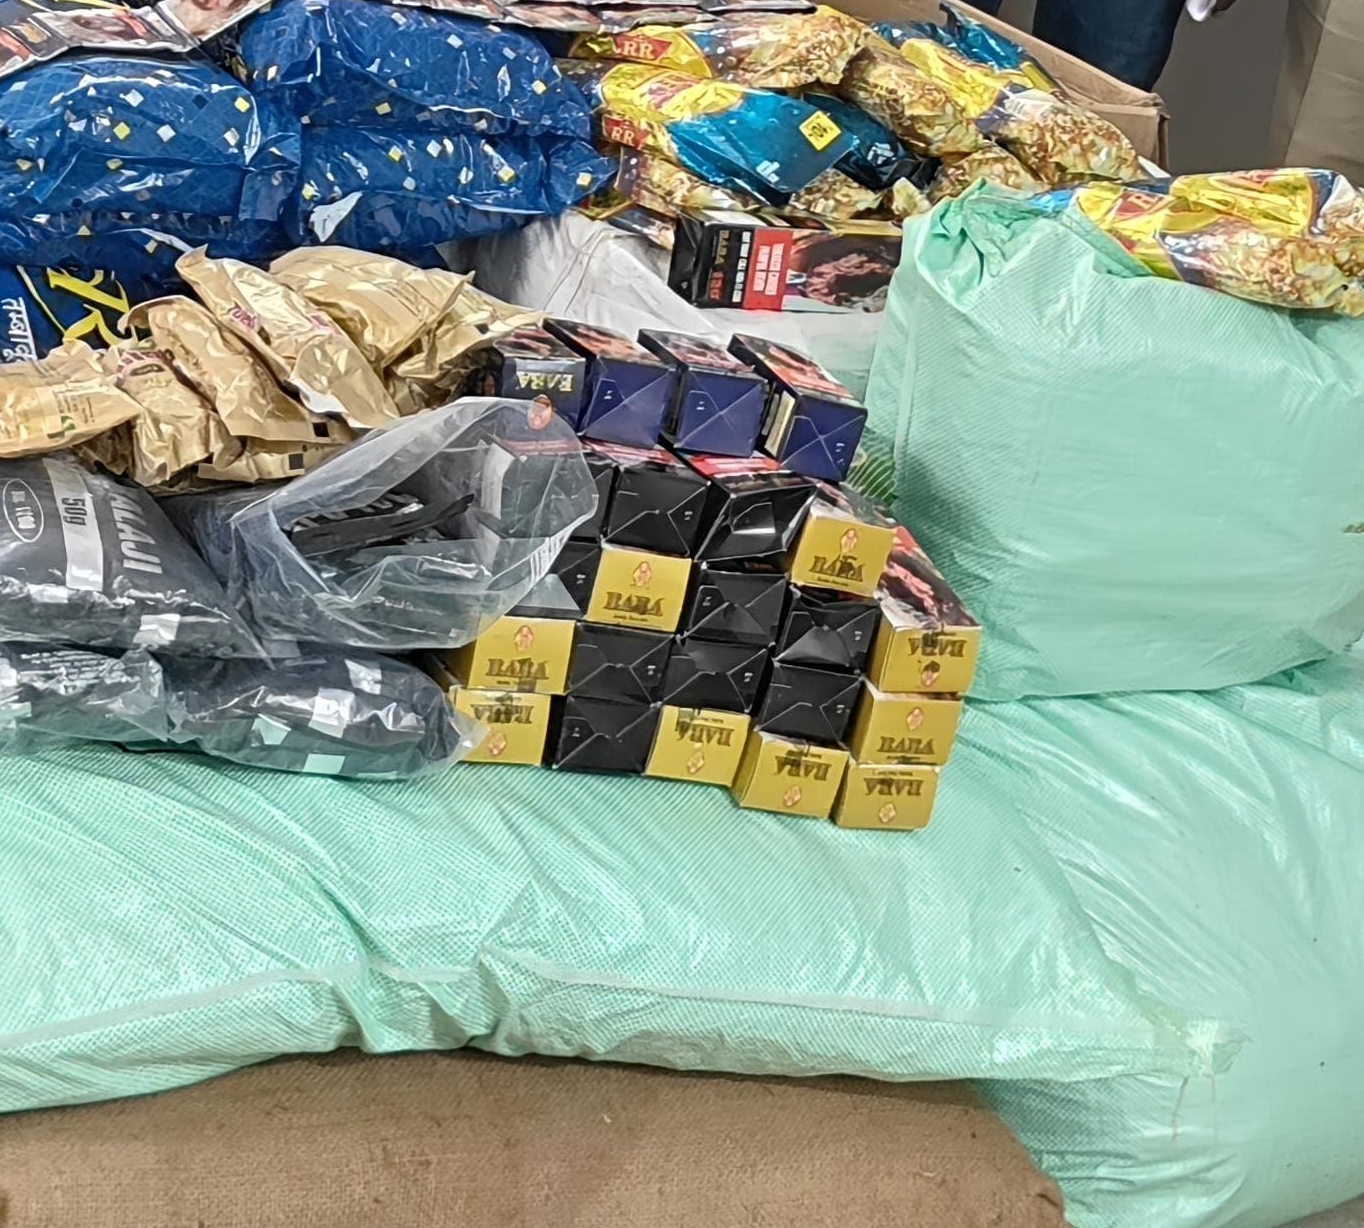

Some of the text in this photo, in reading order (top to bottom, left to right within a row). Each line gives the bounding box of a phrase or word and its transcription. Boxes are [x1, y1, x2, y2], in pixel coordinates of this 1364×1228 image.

[622, 40, 656, 59] RR
[61, 496, 88, 526] 50g
[603, 591, 666, 617] BABA
[485, 656, 550, 680] BABA
[877, 735, 935, 755] BABA
[864, 777, 924, 797] BABA
